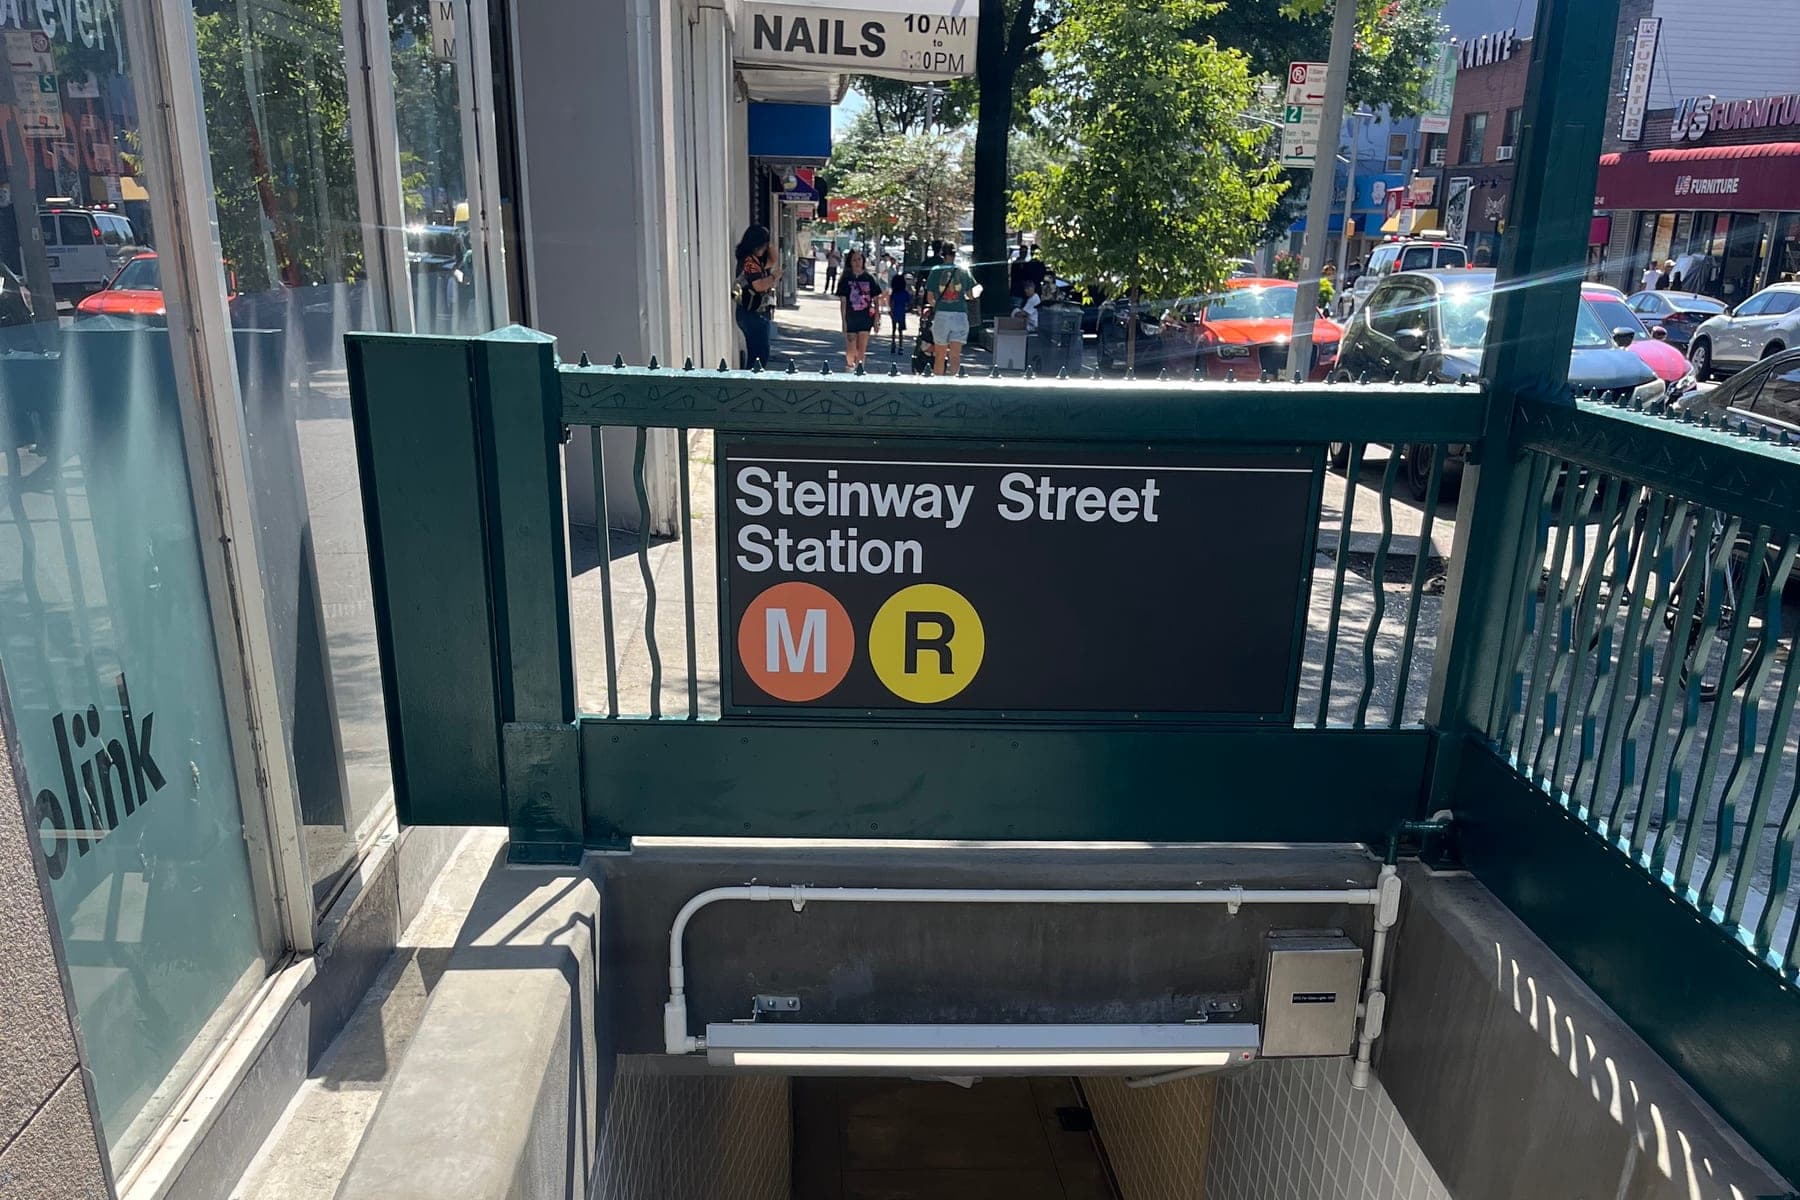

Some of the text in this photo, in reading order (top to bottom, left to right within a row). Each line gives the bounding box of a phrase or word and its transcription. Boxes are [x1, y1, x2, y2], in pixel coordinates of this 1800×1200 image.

[753, 14, 886, 58] NAILS
[904, 14, 966, 36] 10 AM
[933, 38, 943, 48] to
[1457, 27, 1516, 70] KARATE
[1625, 40, 1653, 138] FURNITURE
[1289, 106, 1299, 122] 2
[1690, 177, 1740, 194] FURNITURE
[735, 466, 1160, 529] Steinway Street
[735, 524, 923, 575] Station
[765, 608, 827, 673] M
[903, 611, 956, 675] R
